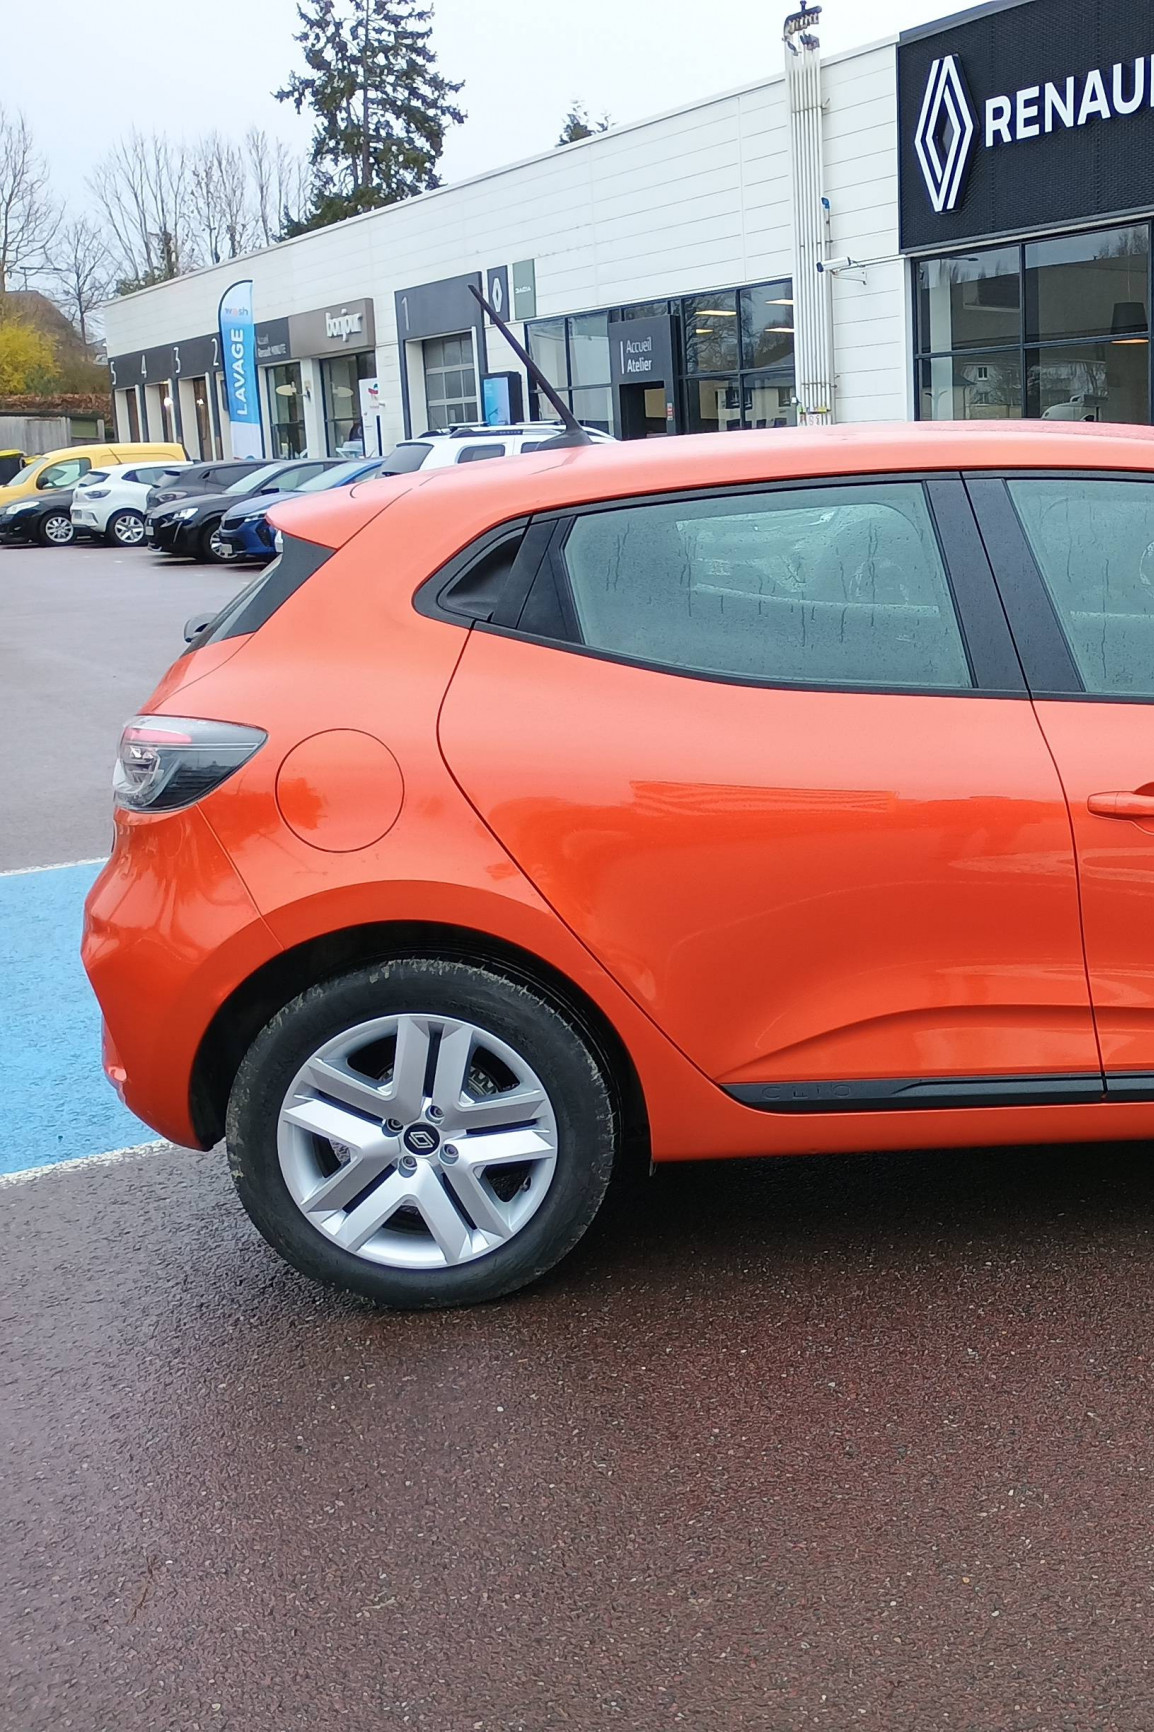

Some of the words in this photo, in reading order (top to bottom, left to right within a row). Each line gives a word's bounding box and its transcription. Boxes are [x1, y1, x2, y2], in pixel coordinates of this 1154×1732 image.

[401, 296, 410, 332] 1
[211, 338, 219, 366] 2
[626, 336, 652, 354] Accueil
[141, 354, 147, 378] 4
[173, 346, 181, 374] 3
[230, 328, 248, 416] LAVAGE
[626, 357, 652, 373] Atelier
[110, 361, 117, 385] 5
[762, 1084, 851, 1100] CLIO
